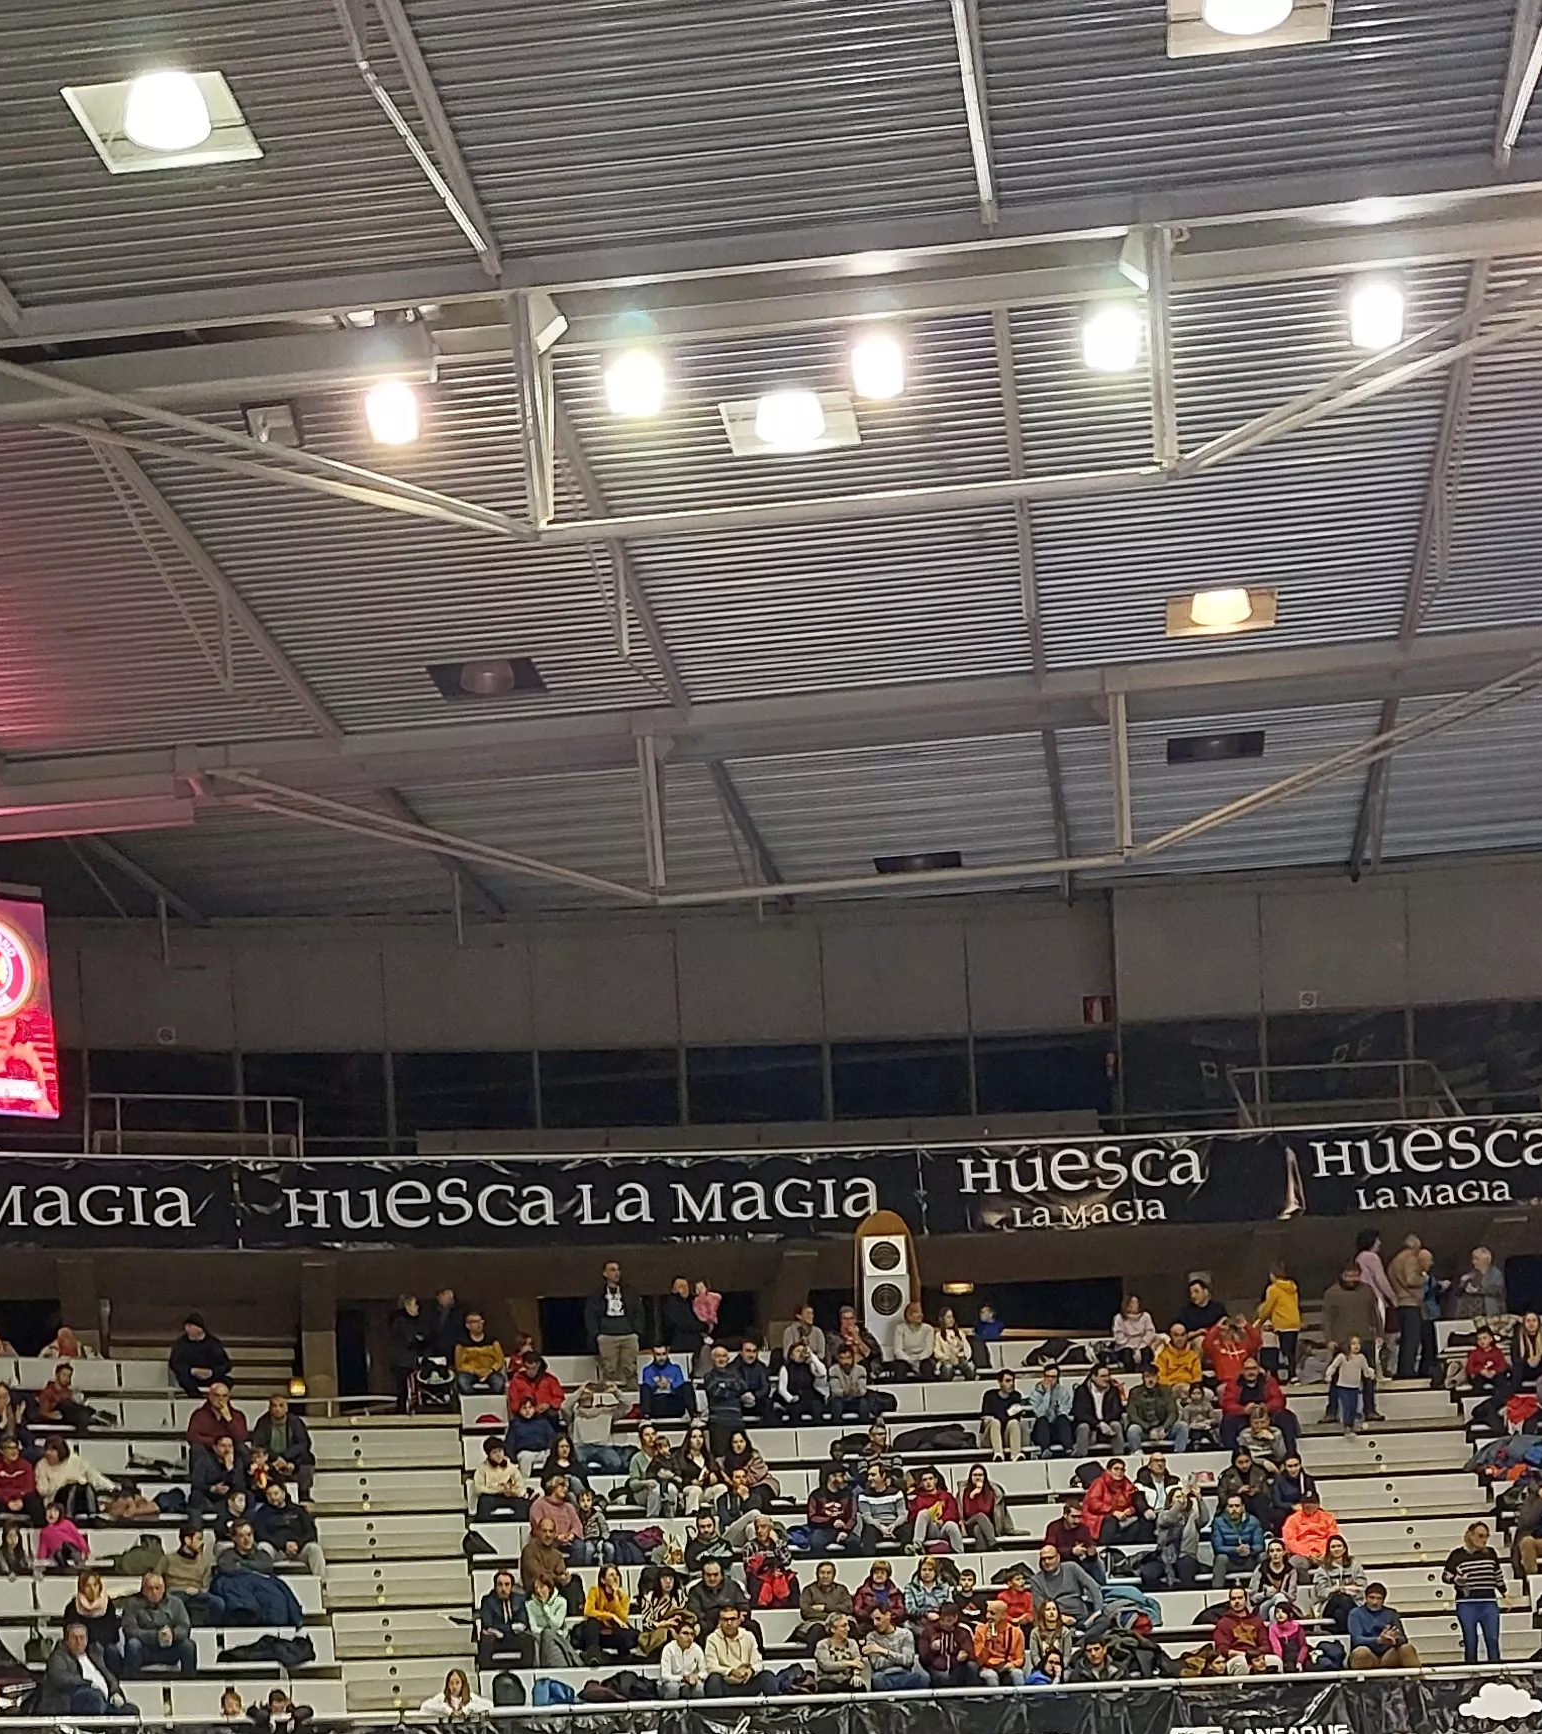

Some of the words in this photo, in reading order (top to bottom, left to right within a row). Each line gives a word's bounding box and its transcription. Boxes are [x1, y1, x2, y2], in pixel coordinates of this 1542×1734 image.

[959, 1142, 1206, 1195] Huesca
[282, 1176, 559, 1228] Huesca
[577, 1181, 655, 1225] La
[1012, 1204, 1051, 1230] La
[1355, 1186, 1398, 1212] La
